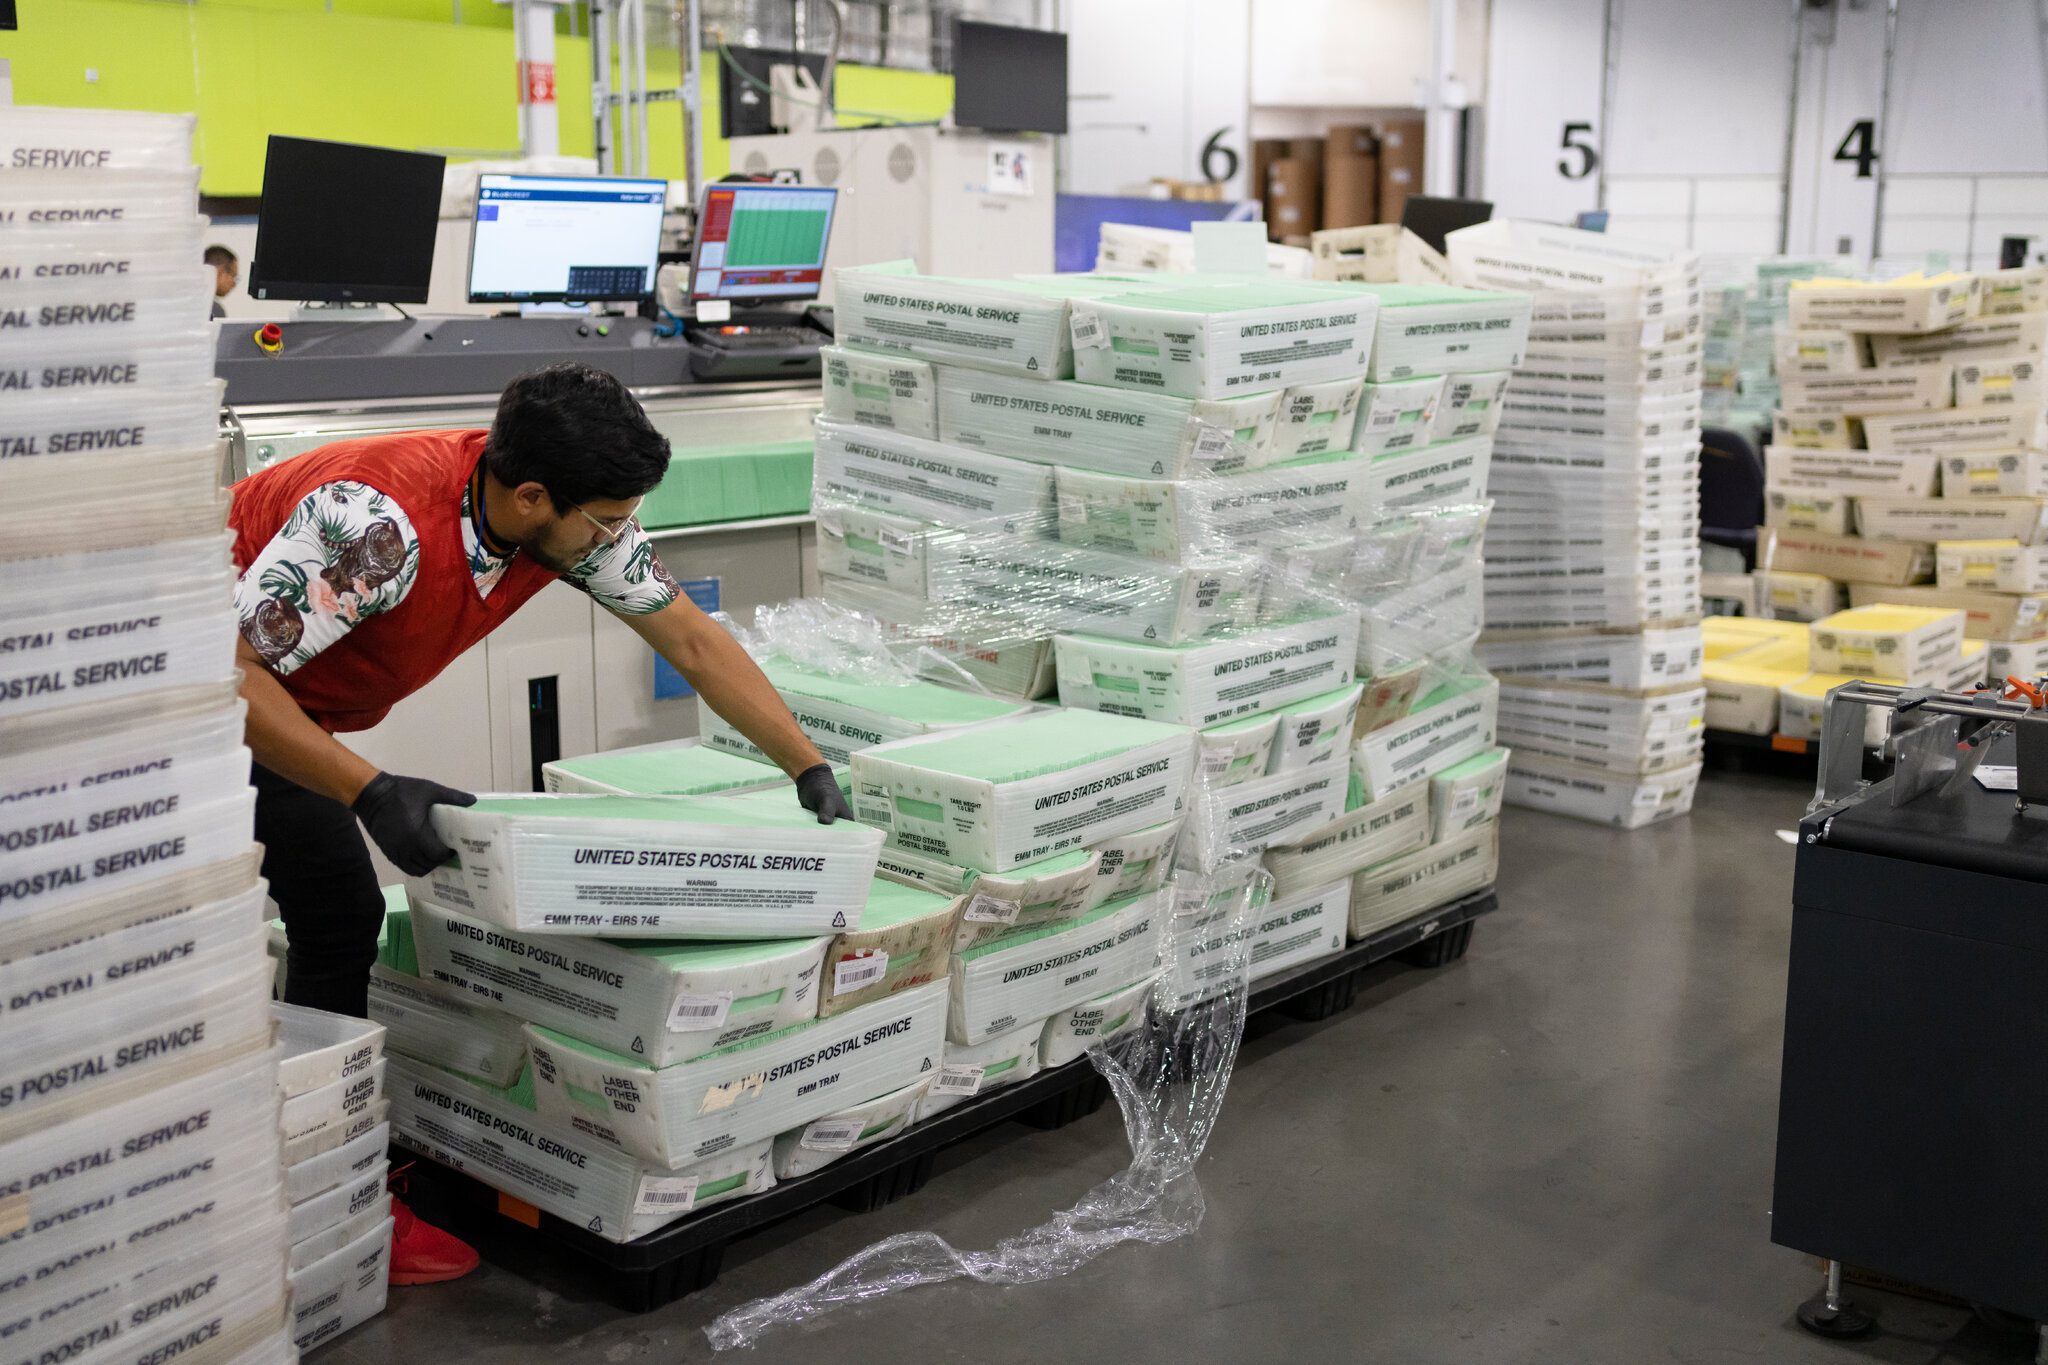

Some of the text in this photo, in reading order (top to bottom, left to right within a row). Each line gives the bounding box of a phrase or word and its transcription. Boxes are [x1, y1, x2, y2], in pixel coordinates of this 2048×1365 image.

[12, 148, 111, 167] SERVICE
[1202, 126, 1239, 183] 6
[1558, 121, 1597, 179] 5
[1834, 119, 1877, 177] 4
[39, 302, 136, 326] SERVICE
[863, 292, 1020, 324] UNITED STATES POSTAL SERVICE
[1240, 313, 1357, 338] UNITED STATES POSTAL SERVICE
[1405, 319, 1512, 336] UNITED STATES SERVICE
[41, 364, 138, 388] SERVICE
[889, 369, 917, 379] LABEL
[889, 378, 918, 389] OTHER
[895, 388, 914, 398] END
[1293, 396, 1314, 404] LABEL
[970, 392, 1146, 426] UNITED STATES POSTAL SERVICE
[1290, 405, 1313, 414] OTHER
[1291, 414, 1307, 423] END
[48, 426, 145, 454] SERVICE
[1033, 426, 1073, 439] EMM TRAY
[845, 442, 999, 486] UNITED STATES POSTAL SERVICE
[1385, 456, 1473, 488] UNITED STATES POSTAL SERVICE
[1280, 480, 1347, 500] POSTAL SERVICE
[1199, 599, 1213, 607] END
[1214, 635, 1338, 677] UNITED STATES POSTAL SERVICE
[73, 652, 168, 688] SERVICE
[1204, 708, 1232, 723] EMM TRAY
[1300, 720, 1321, 730] LABEL
[800, 714, 882, 745] POSTAL SERVICE
[1297, 729, 1319, 739] OTHER
[1387, 704, 1481, 751] UNITED STATES POSTAL SERVICE
[713, 735, 744, 749] EMM TRAY
[1035, 758, 1170, 811] UNITED STATES POSTAL SERVICE
[1303, 778, 1331, 796] SERVICE
[86, 795, 180, 833] SERVICE
[950, 798, 981, 809] TARE WEIGHT
[1301, 802, 1414, 855] PROPERTY POSTAL SERVICE
[898, 839, 950, 857] POSTAL SERVICE
[899, 832, 946, 848] UNITED STATES
[1015, 835, 1082, 862] EMM TRAY EIRS 74E
[0, 836, 186, 900] POSTAL SERVICE
[574, 849, 826, 872] UNITED STATES POSTAL SERVICE
[1097, 867, 1114, 876] END
[545, 914, 660, 926] EMM TRAY EIRS 74E
[1258, 903, 1324, 935] POSTAL SERVICE
[447, 919, 624, 990] UNITED STATES POSTAL SERVICE
[1003, 919, 1150, 983] UNITED STATES POSTAL SERVICE
[518, 966, 541, 979] WARNING
[1065, 967, 1099, 986] EMM TRAY
[433, 969, 503, 1002] EMM TRAY EIRS 74E
[1070, 1018, 1103, 1027] OTHER
[1074, 1009, 1105, 1019] LABEL
[712, 1025, 773, 1048] POSTAL SERVICE
[719, 1020, 774, 1040] UNITED STATES
[1074, 1027, 1096, 1036] END
[344, 1046, 373, 1065] LABEL
[531, 1045, 553, 1063] LABEL
[768, 1053, 815, 1082] STATES
[817, 1038, 862, 1064] POSTAL
[864, 1017, 913, 1046] SERVICE
[20, 1022, 206, 1100] POSTAL SERVICE
[342, 1057, 371, 1078] OTHER
[534, 1055, 556, 1075] OTHER
[345, 1076, 375, 1098] LABEL
[540, 1069, 555, 1084] END
[602, 1074, 638, 1091] LABEL
[797, 1073, 840, 1097] EMM TRAY
[343, 1087, 375, 1109] OTHER
[604, 1086, 641, 1102] OTHER
[614, 1099, 636, 1113] END
[121, 1110, 212, 1159] SERVICE
[345, 1117, 375, 1138] LABEL
[415, 1084, 588, 1169] UNITED STATES POSTAL SERVICE
[702, 1133, 730, 1147] WARNING
[414, 1139, 464, 1170] TRAY EIRS 74E
[352, 1178, 380, 1201] LABEL
[349, 1189, 379, 1214] OTHER
[130, 1275, 219, 1328] SERVICE
